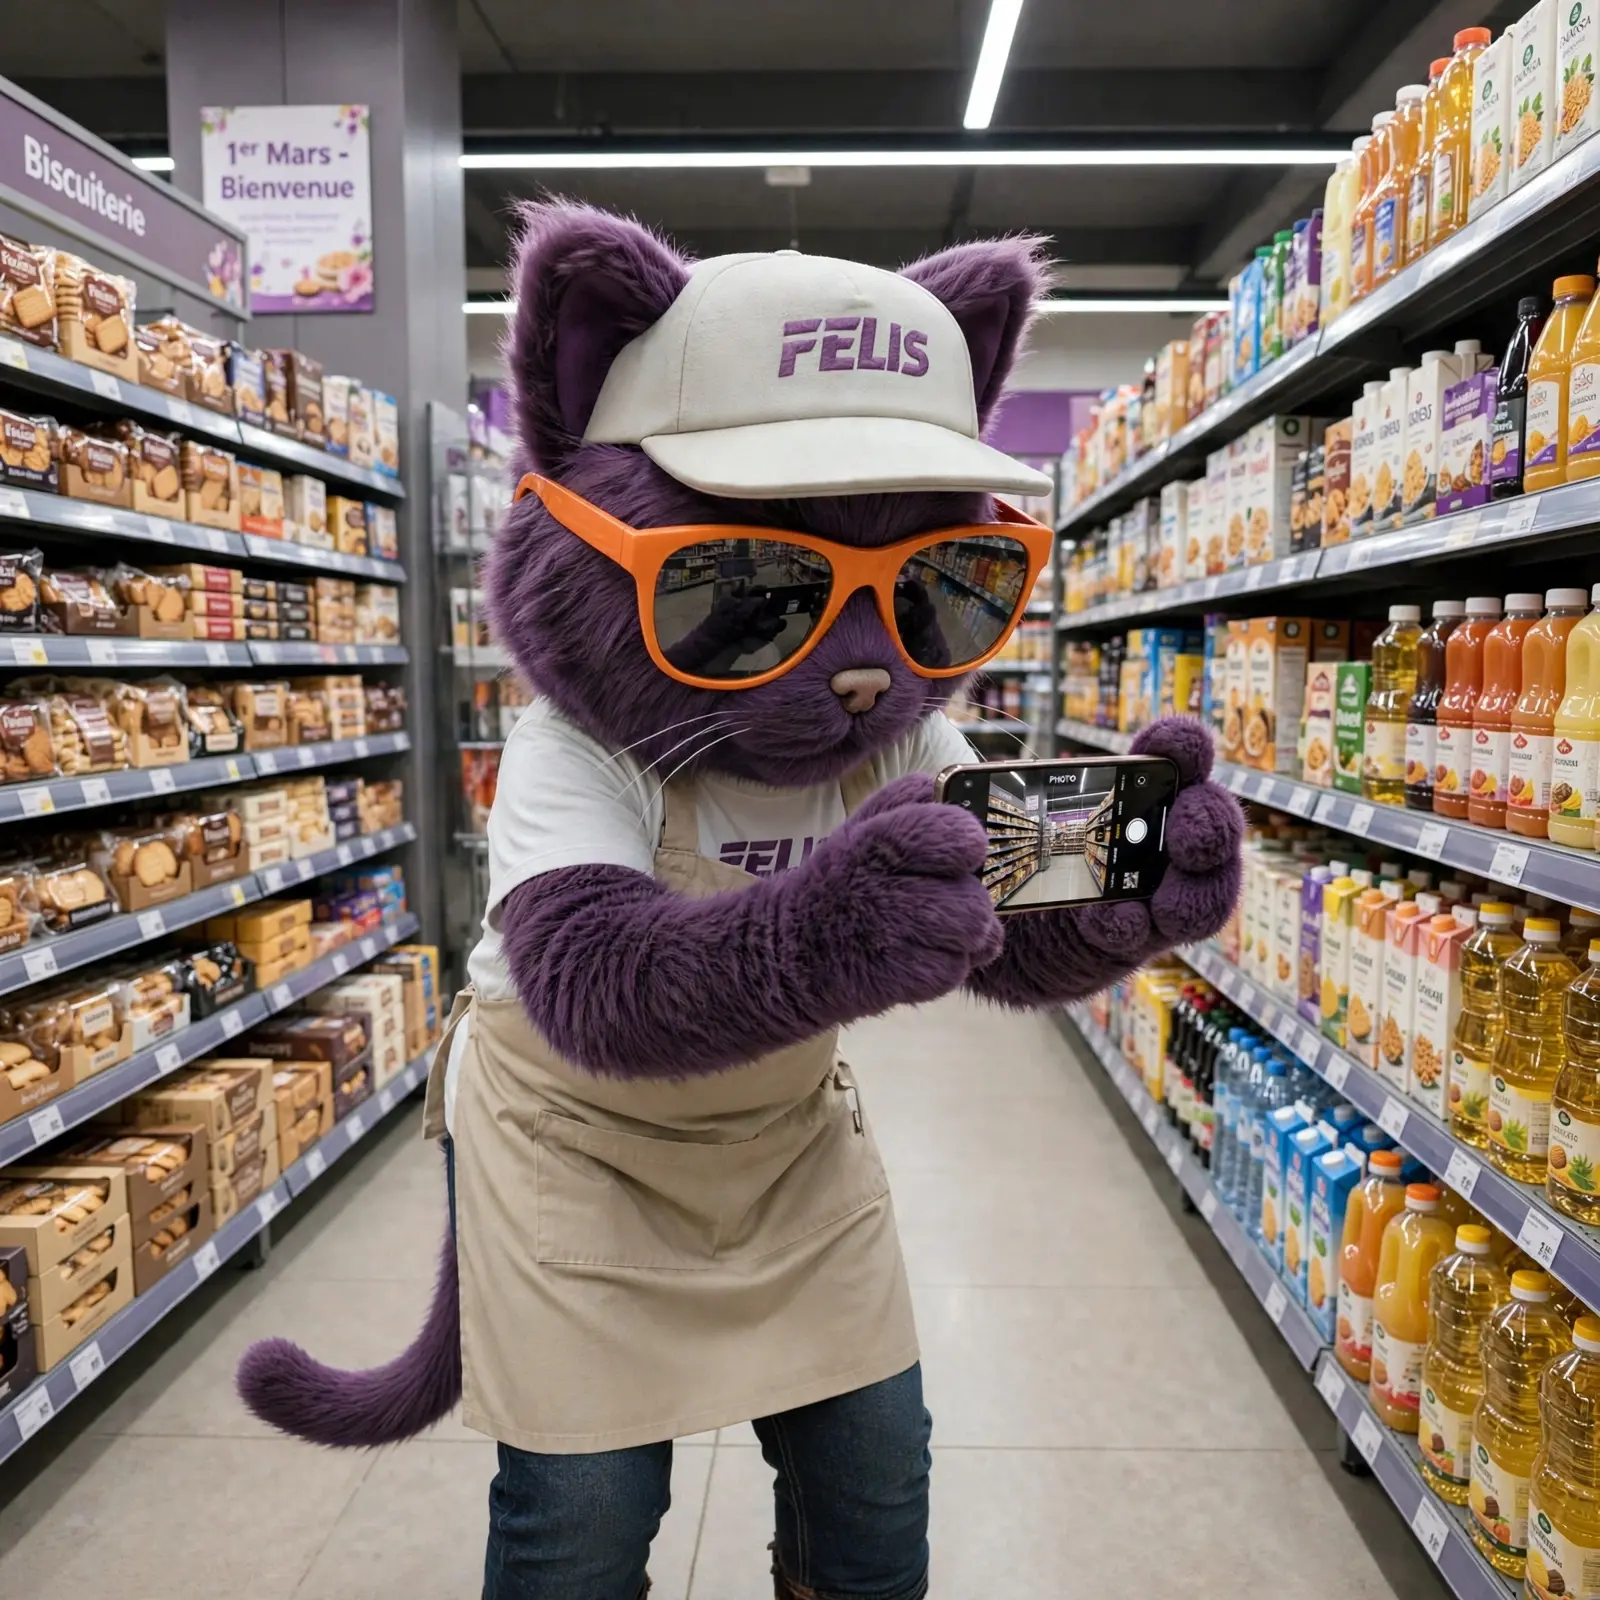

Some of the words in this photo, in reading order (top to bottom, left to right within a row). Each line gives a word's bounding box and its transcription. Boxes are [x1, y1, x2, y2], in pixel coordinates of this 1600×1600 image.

[267, 141, 331, 166] Mars
[24, 134, 146, 237] Biscuiterie
[221, 175, 355, 200] Bienvenue
[778, 316, 930, 378] FELIS
[1049, 774, 1077, 784] PHOTO
